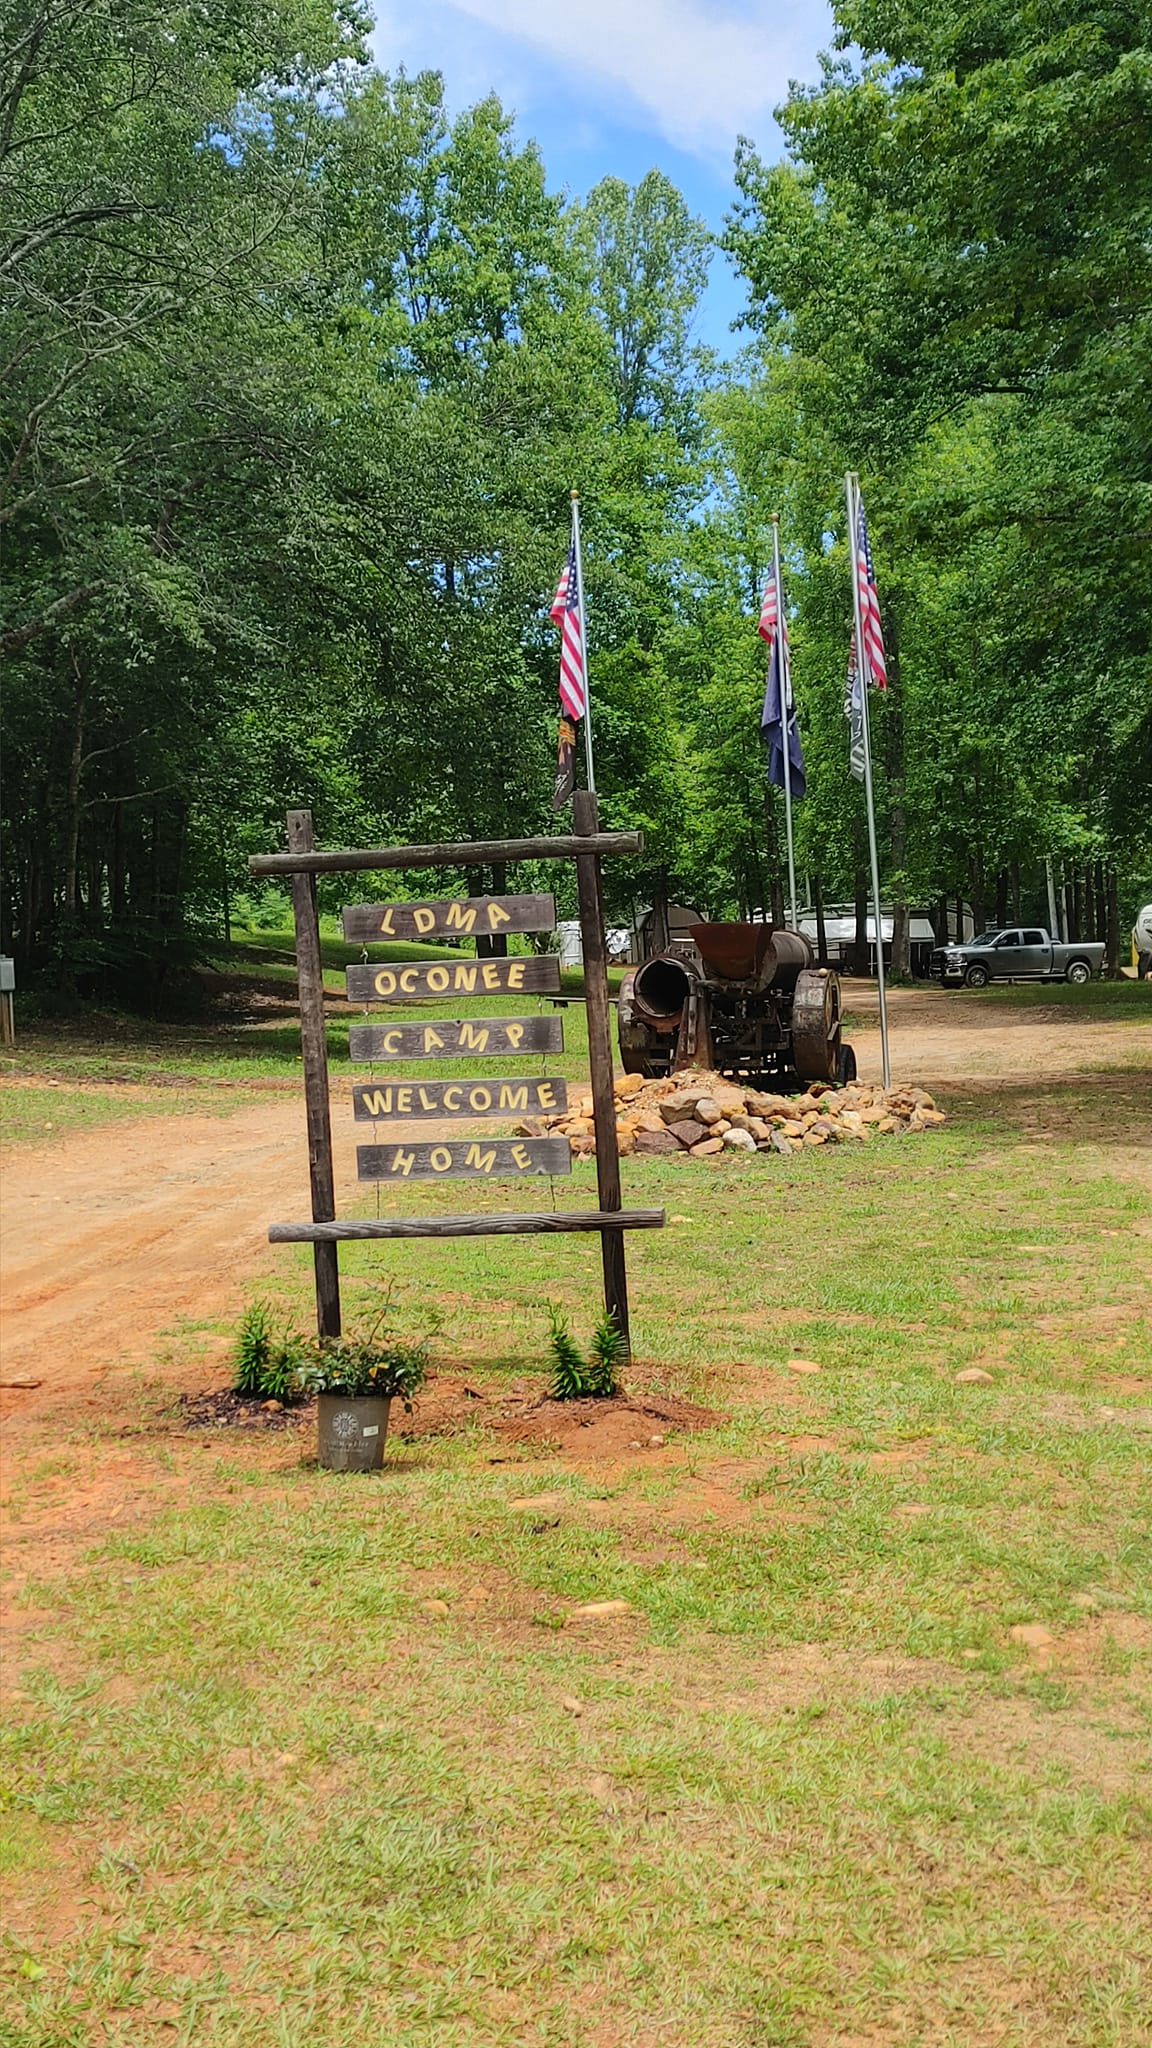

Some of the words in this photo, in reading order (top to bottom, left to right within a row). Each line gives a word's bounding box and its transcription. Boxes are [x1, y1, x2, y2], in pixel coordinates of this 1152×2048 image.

[380, 903, 511, 934] LDMA
[374, 963, 526, 995] OCONEE
[383, 1023, 525, 1054] CAMP
[362, 1082, 557, 1116] WELCOME
[391, 1143, 532, 1176] HOME
